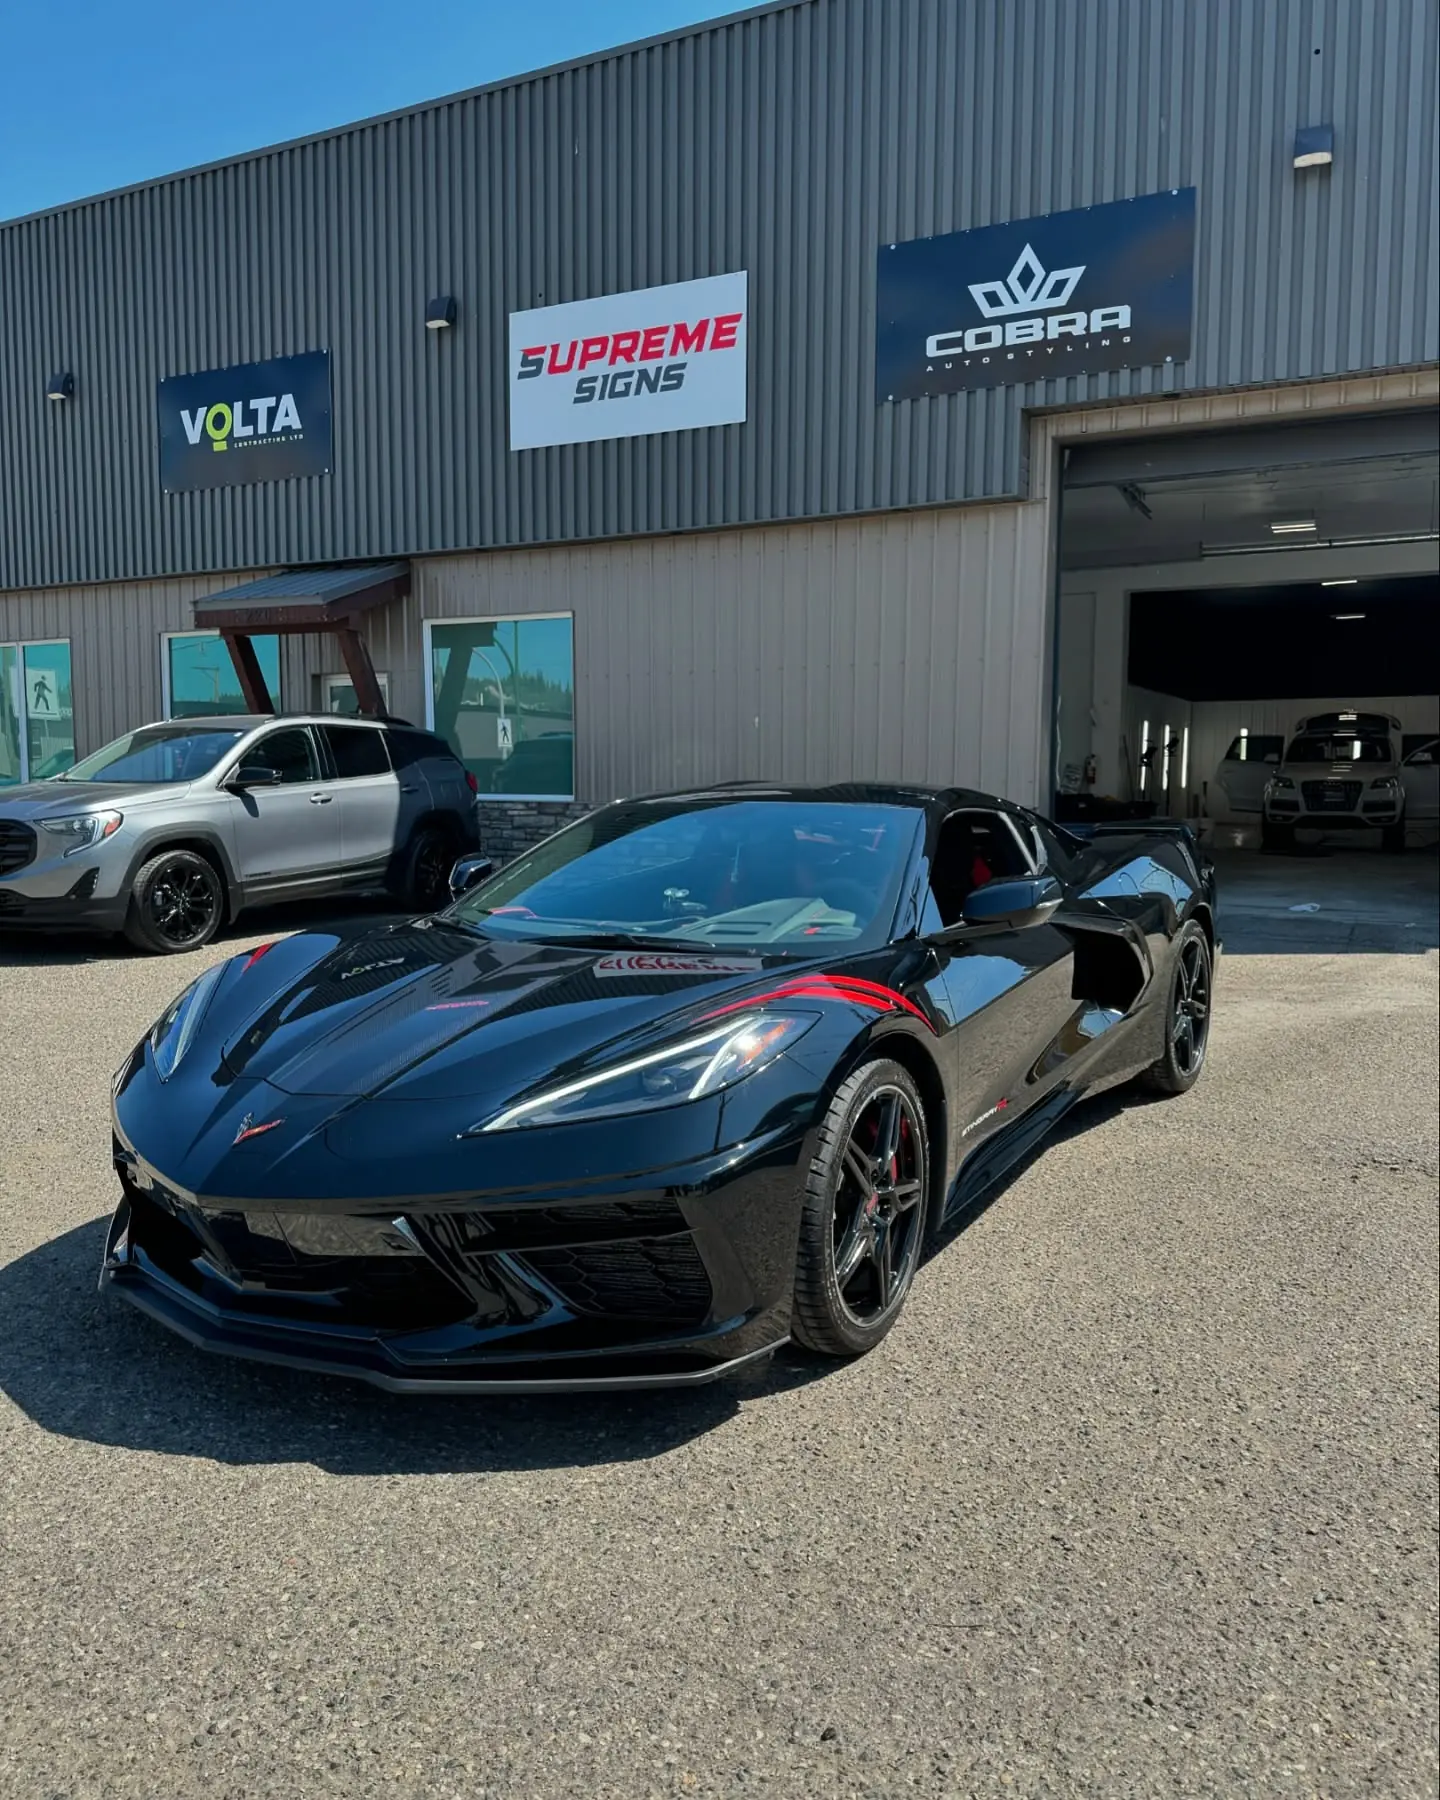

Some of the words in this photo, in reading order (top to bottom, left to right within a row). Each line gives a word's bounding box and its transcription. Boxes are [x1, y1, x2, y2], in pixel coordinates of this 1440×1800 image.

[517, 313, 743, 380] SUPREME
[926, 304, 1132, 358] COBRA
[573, 362, 687, 404] SIGNS
[180, 393, 302, 446] VOLTA
[233, 435, 286, 448] CONTRACTING
